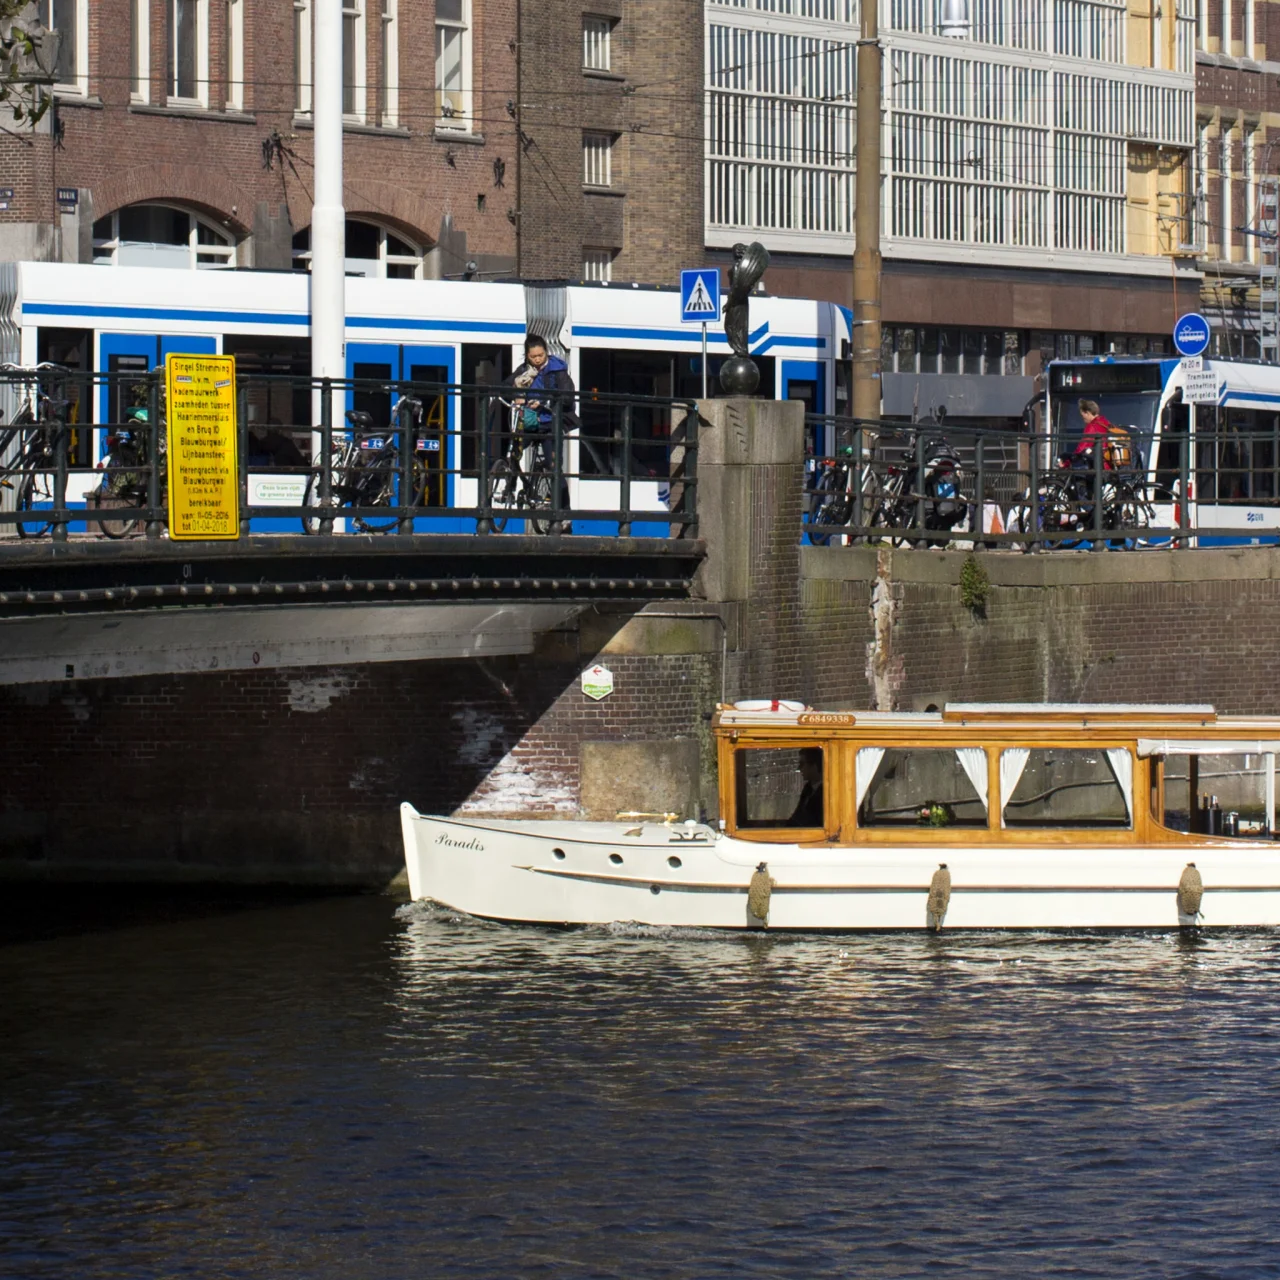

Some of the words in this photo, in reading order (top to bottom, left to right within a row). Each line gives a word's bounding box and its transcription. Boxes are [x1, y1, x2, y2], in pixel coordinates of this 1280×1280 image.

[174, 362, 194, 373] Singel
[196, 363, 230, 375] Stremming
[1188, 360, 1195, 368] 20
[1062, 371, 1073, 387] 14
[174, 401, 208, 409] zaamheden
[210, 401, 231, 409] tussen
[177, 412, 230, 422] Haarlemmersluis
[197, 425, 212, 435] Brug
[213, 425, 220, 434] 10
[182, 450, 225, 460] Lijnbaansteeg
[180, 466, 218, 476] Herengracht
[189, 499, 221, 507] bereikbaar
[197, 511, 229, 520] 11-05-2016
[182, 521, 191, 531] tot
[192, 520, 228, 532] 01-04-2018
[808, 714, 850, 723] 6849338
[435, 831, 484, 851] Paradis
